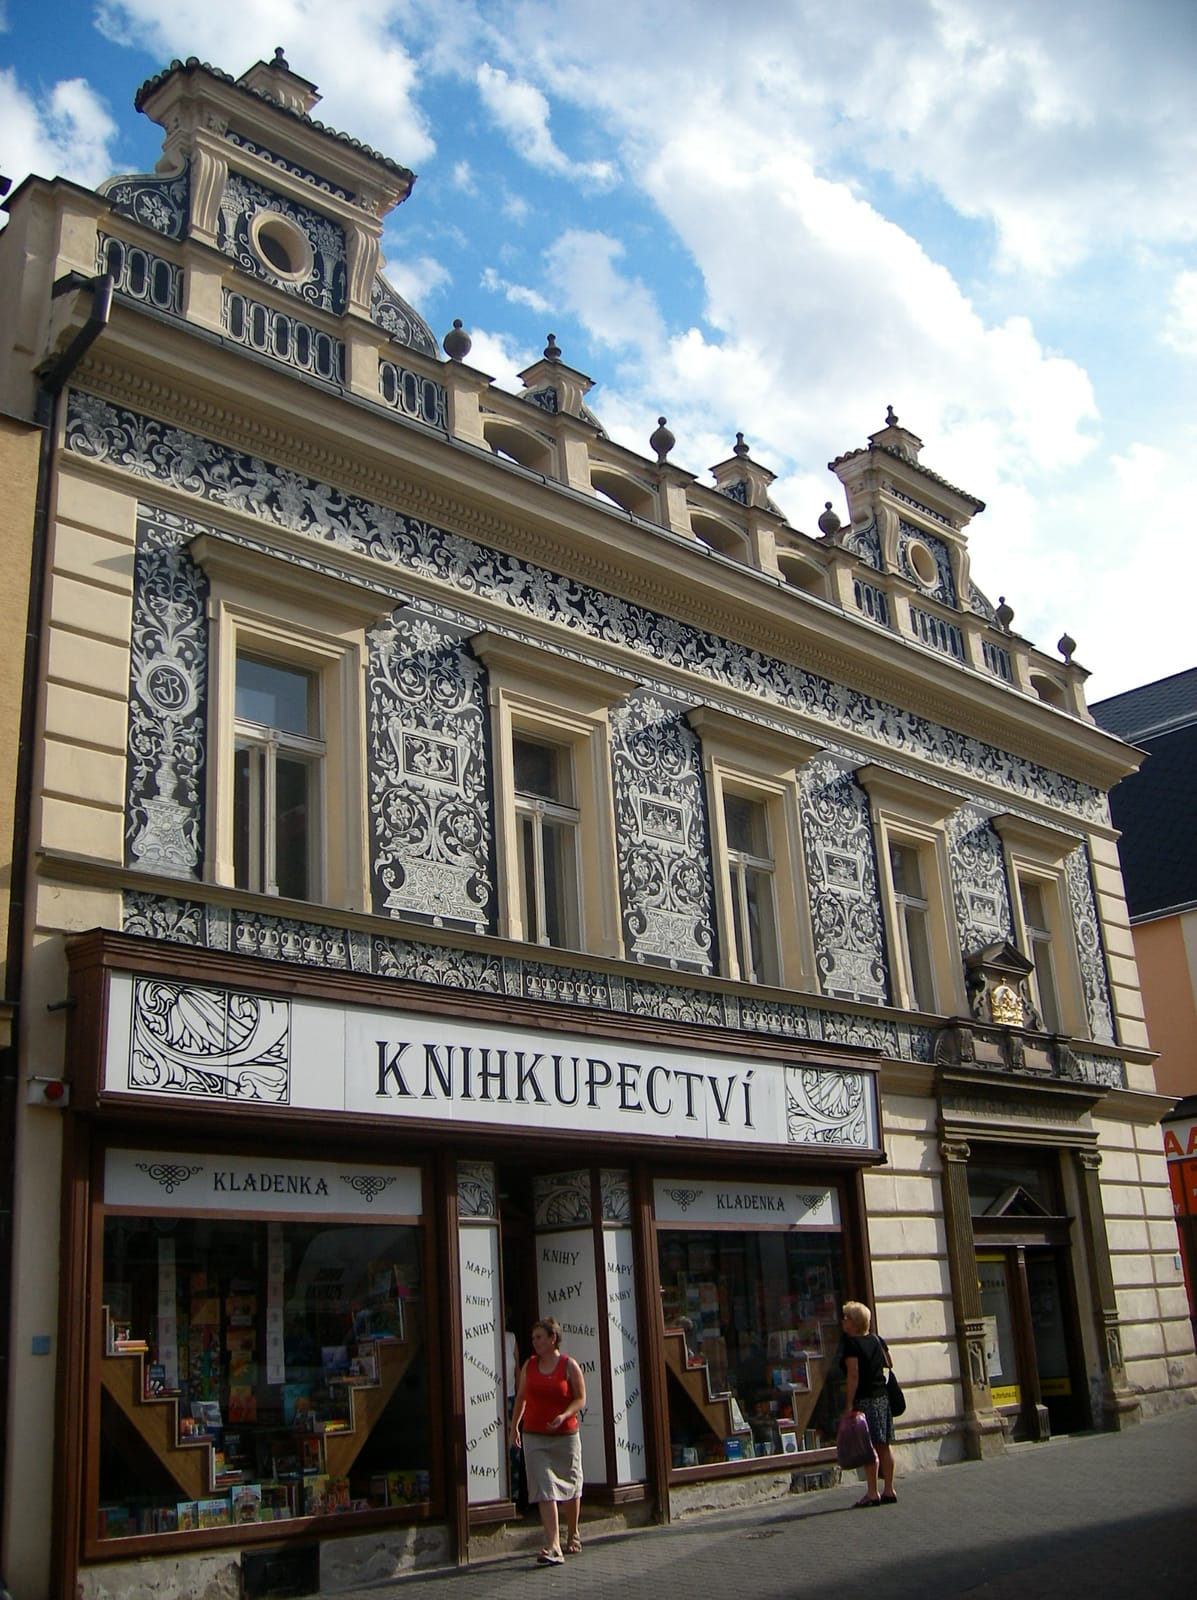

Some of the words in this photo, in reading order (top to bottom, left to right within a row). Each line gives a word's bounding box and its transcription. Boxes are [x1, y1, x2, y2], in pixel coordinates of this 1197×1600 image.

[375, 1040, 756, 1129] KNIHKUPECTVÍ
[213, 1171, 329, 1196] KLADENKA
[716, 1193, 785, 1212] KLADENKA
[542, 1248, 580, 1266] KNIHY
[465, 1260, 494, 1279] MAPY
[607, 1262, 633, 1276] MAPY
[465, 1294, 493, 1308] KNIHY
[547, 1281, 583, 1304] MAPY
[609, 1287, 632, 1303] KNIHY
[464, 1318, 496, 1340] KNIHY
[613, 1357, 637, 1377] KNIHY
[470, 1388, 497, 1406] KNIHY
[616, 1437, 644, 1456] MAPY
[470, 1464, 500, 1479] MAPY
